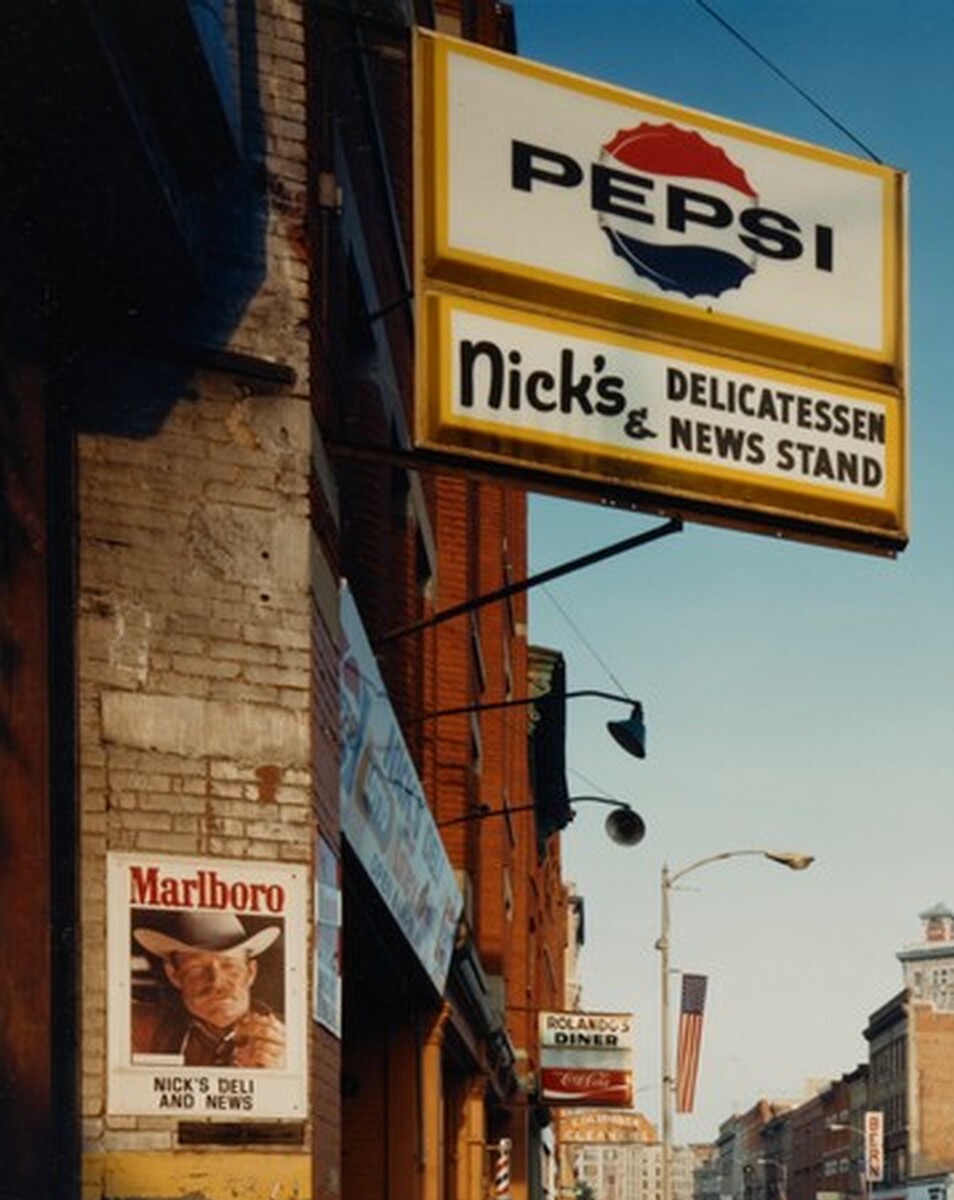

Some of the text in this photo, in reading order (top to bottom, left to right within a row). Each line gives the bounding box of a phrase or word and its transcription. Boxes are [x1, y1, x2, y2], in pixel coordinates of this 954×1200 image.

[511, 139, 834, 273] PEPSI
[459, 337, 657, 440] Nick's &
[667, 367, 886, 445] DELICATESSEN
[670, 415, 883, 489] NEWS STAND
[129, 866, 285, 913] Marlboro
[555, 1032, 618, 1046] DINER
[154, 1076, 254, 1095] NICK'S DELI
[159, 1095, 254, 1111] AND NEWS
